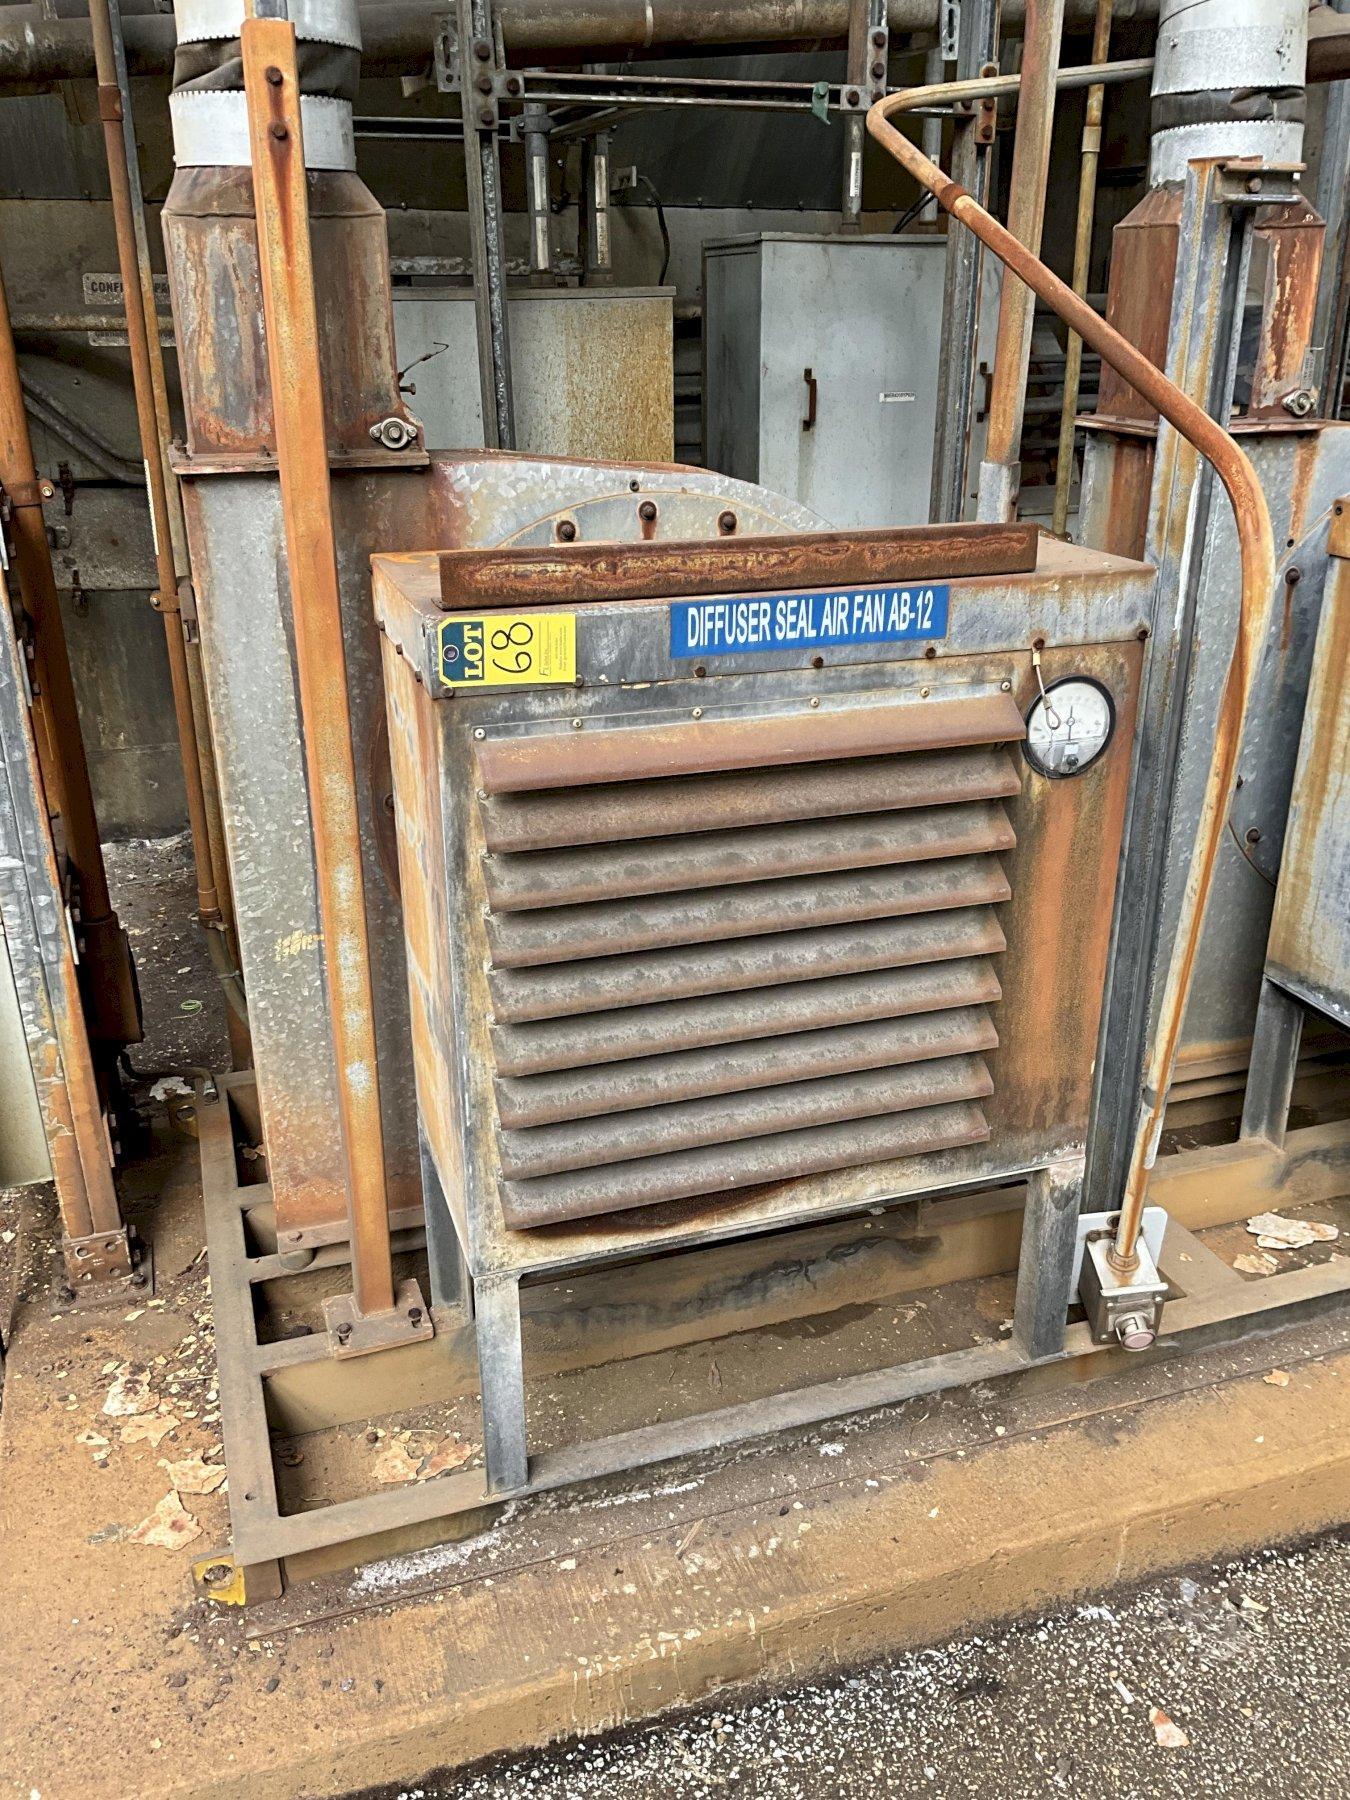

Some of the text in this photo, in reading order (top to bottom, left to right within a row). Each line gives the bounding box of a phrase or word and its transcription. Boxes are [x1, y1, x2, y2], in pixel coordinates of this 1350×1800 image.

[687, 590, 934, 647] DIFFUSER SEAL AIR FAN AB-12
[463, 624, 483, 678] LOT
[491, 621, 534, 673] 68
